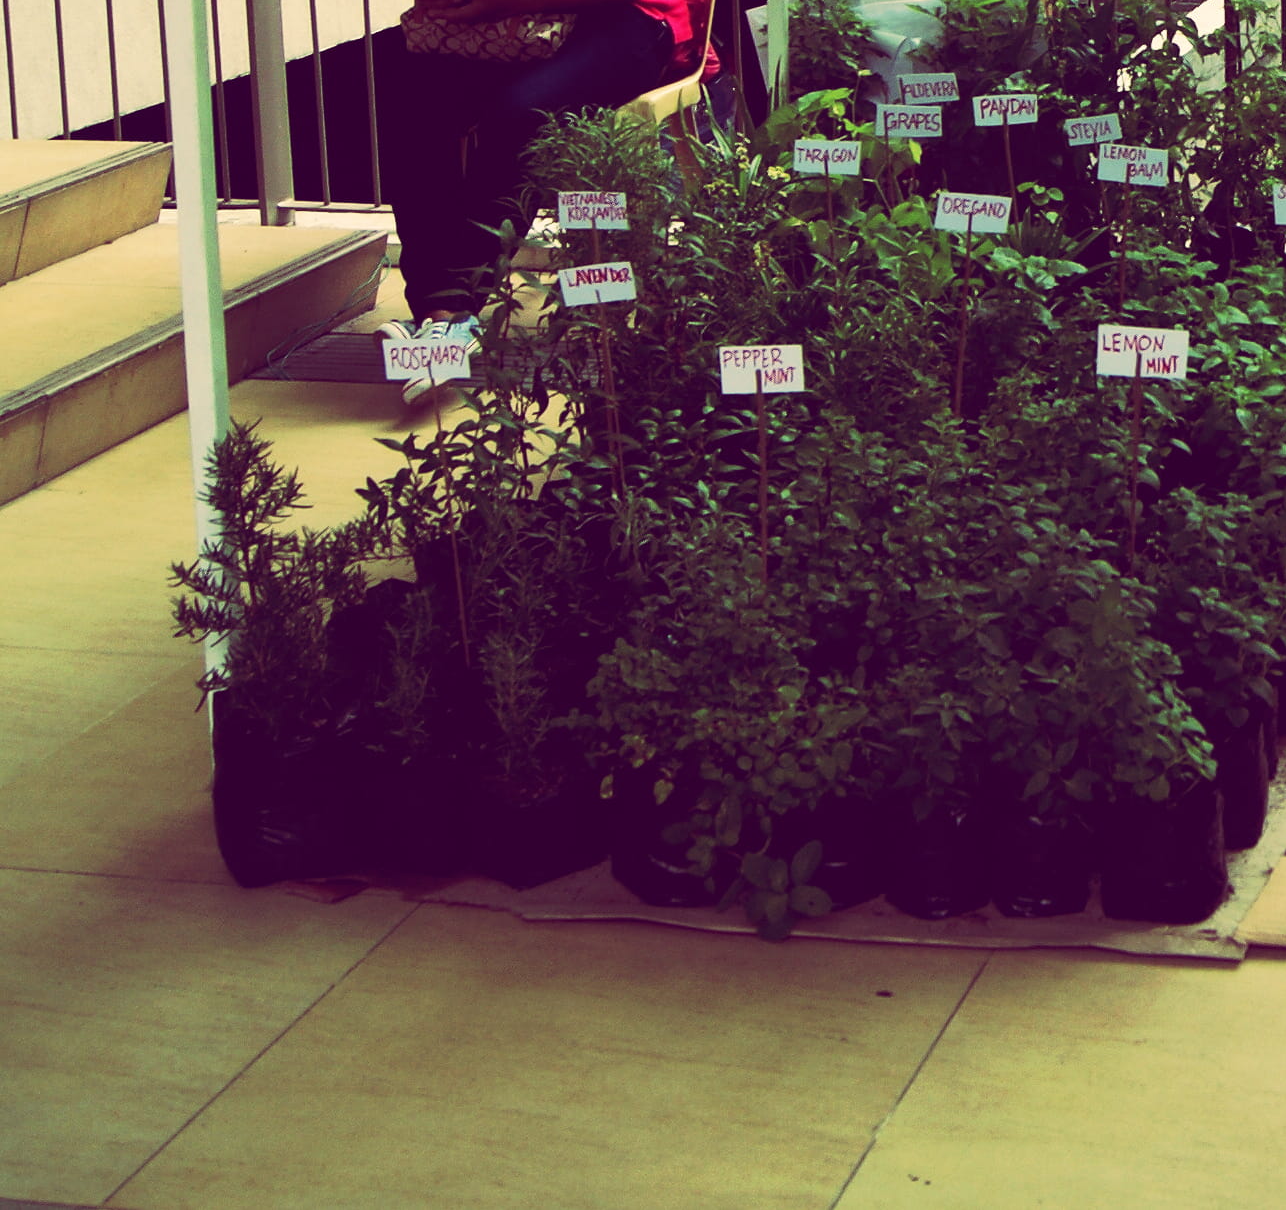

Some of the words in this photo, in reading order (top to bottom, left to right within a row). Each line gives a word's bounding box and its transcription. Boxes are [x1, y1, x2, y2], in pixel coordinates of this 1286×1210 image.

[979, 98, 1037, 120] PANDAN
[886, 112, 940, 132] GRAPES
[796, 146, 859, 164] TARAGON
[1103, 144, 1147, 161] LEMON
[1126, 162, 1164, 180] BALM
[941, 196, 1007, 219] OREGANO
[1102, 333, 1166, 353] LEMON
[390, 344, 467, 371] ROSEMARY
[722, 347, 783, 369] PEPPER
[1146, 355, 1179, 375] MINT
[764, 366, 796, 388] MINT
